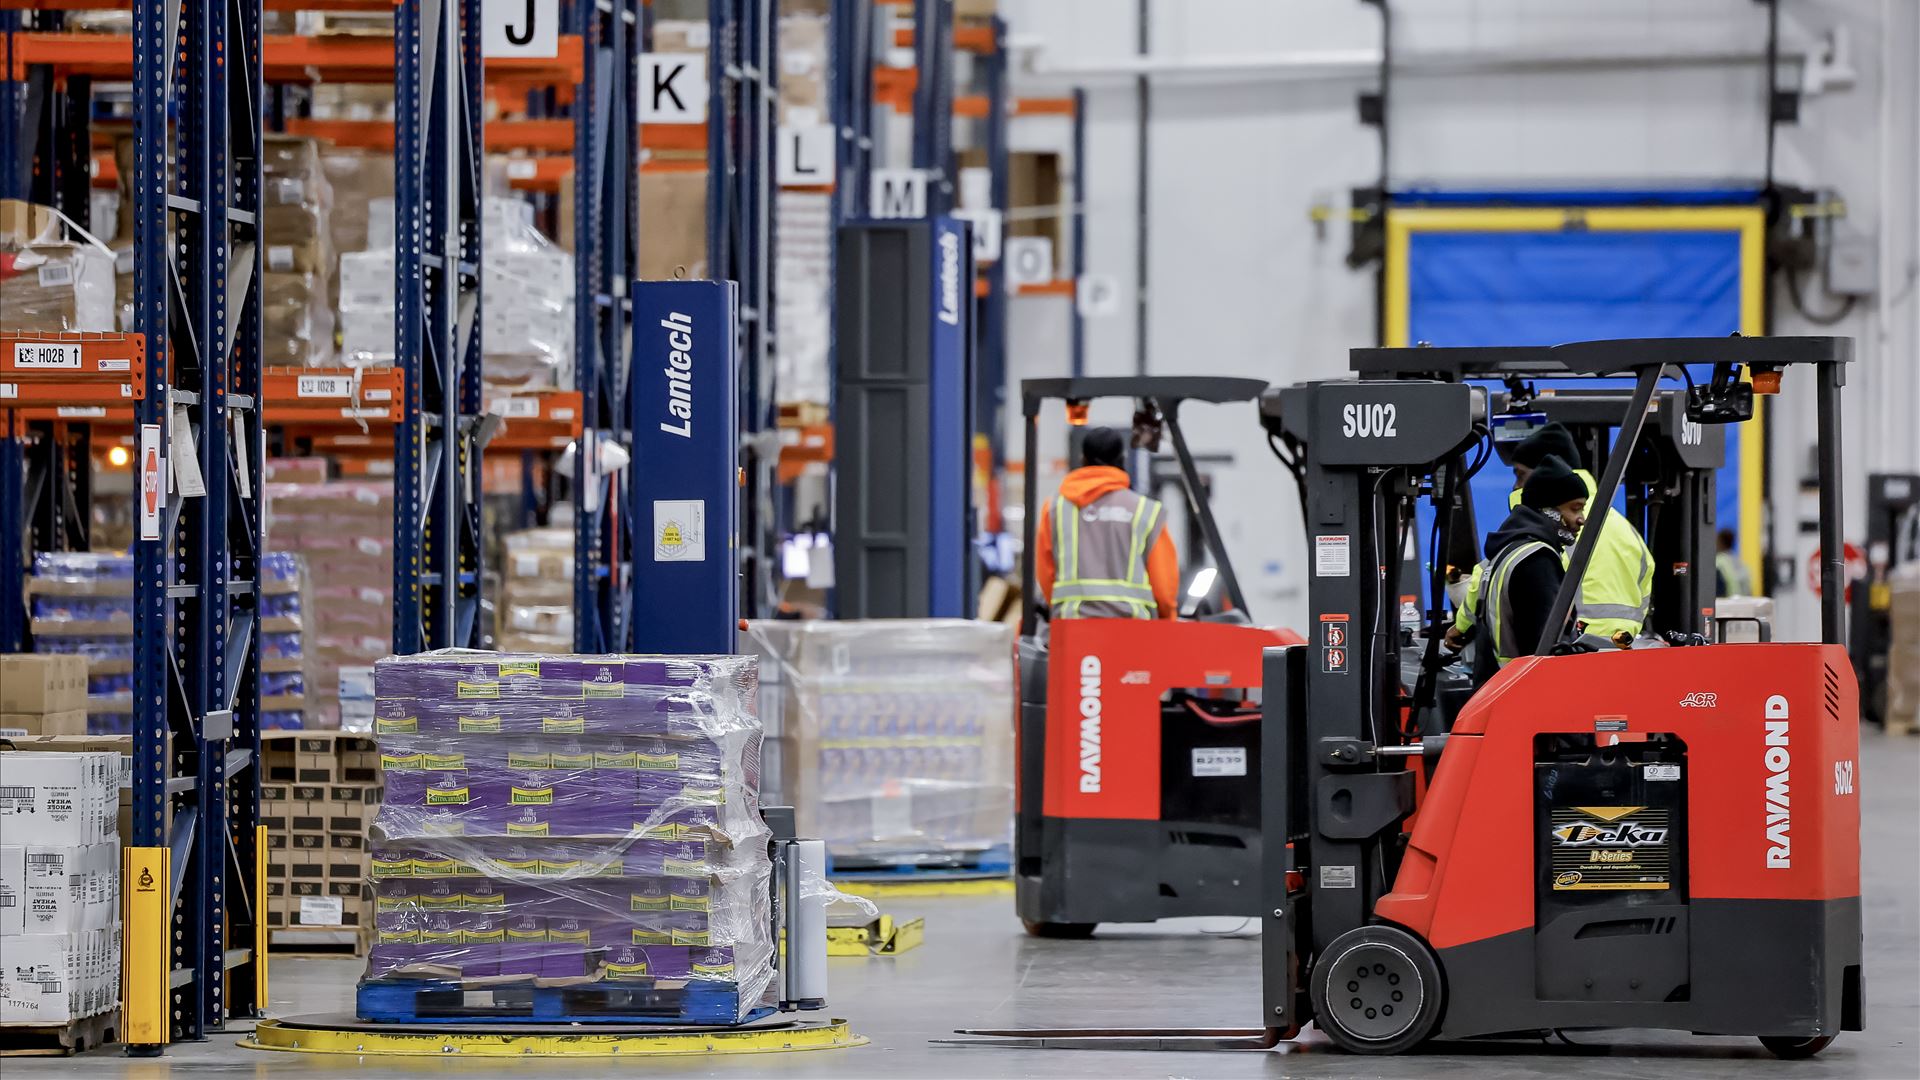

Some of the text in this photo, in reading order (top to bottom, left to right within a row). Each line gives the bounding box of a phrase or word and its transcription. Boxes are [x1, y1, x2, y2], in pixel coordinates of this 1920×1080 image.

[653, 64, 687, 111] K
[795, 135, 817, 175] L
[883, 180, 914, 218] M
[39, 348, 64, 363] H02B
[660, 311, 692, 438] Lantech
[1343, 403, 1397, 438] SU02
[1679, 693, 1717, 707] ACR
[1079, 655, 1102, 793] RAYMOND
[1765, 694, 1791, 869] RAYMOND
[1553, 822, 1667, 846] Deka
[1590, 850, 1633, 862] D-Series
[8, 1000, 39, 1010] 1171764
